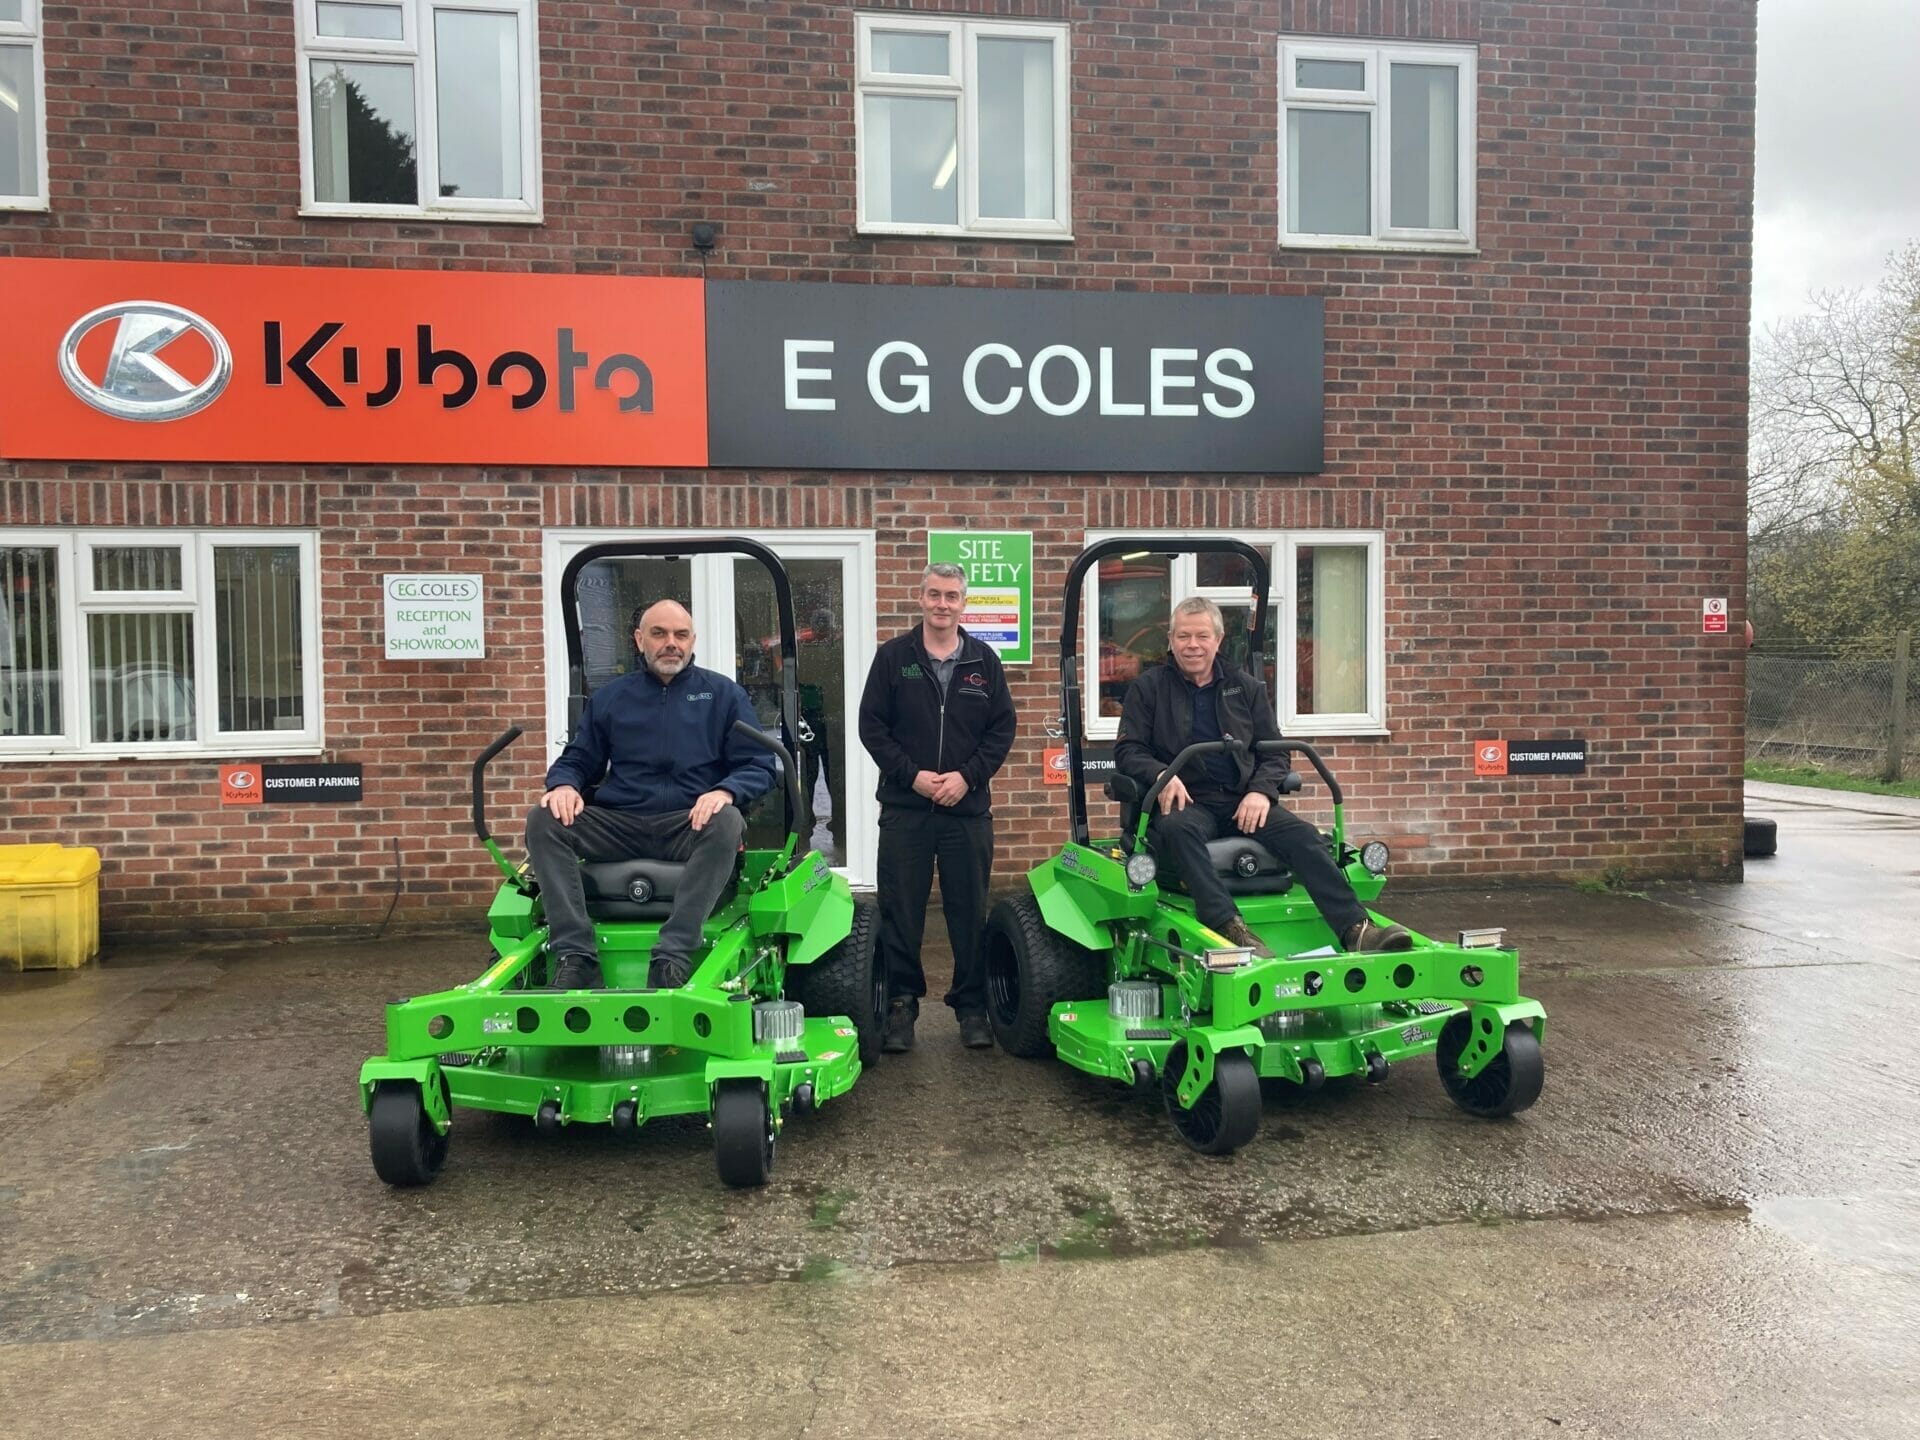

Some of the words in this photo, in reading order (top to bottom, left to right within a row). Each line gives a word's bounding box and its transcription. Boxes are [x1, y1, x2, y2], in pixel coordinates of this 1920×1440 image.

[264, 321, 655, 414] Kubota
[783, 339, 836, 411] E
[867, 340, 931, 414] G
[963, 342, 1256, 419] COLES
[958, 539, 1004, 560] SITE
[957, 563, 1023, 582] AFETY
[397, 610, 471, 622] RECEPTION
[422, 624, 446, 636] and
[390, 638, 479, 650] SHOWROOM
[1510, 752, 1551, 762] CUSTOMER
[1551, 751, 1584, 761] PARKING
[265, 777, 317, 788] CUSTOMER
[318, 776, 360, 787] PARKING
